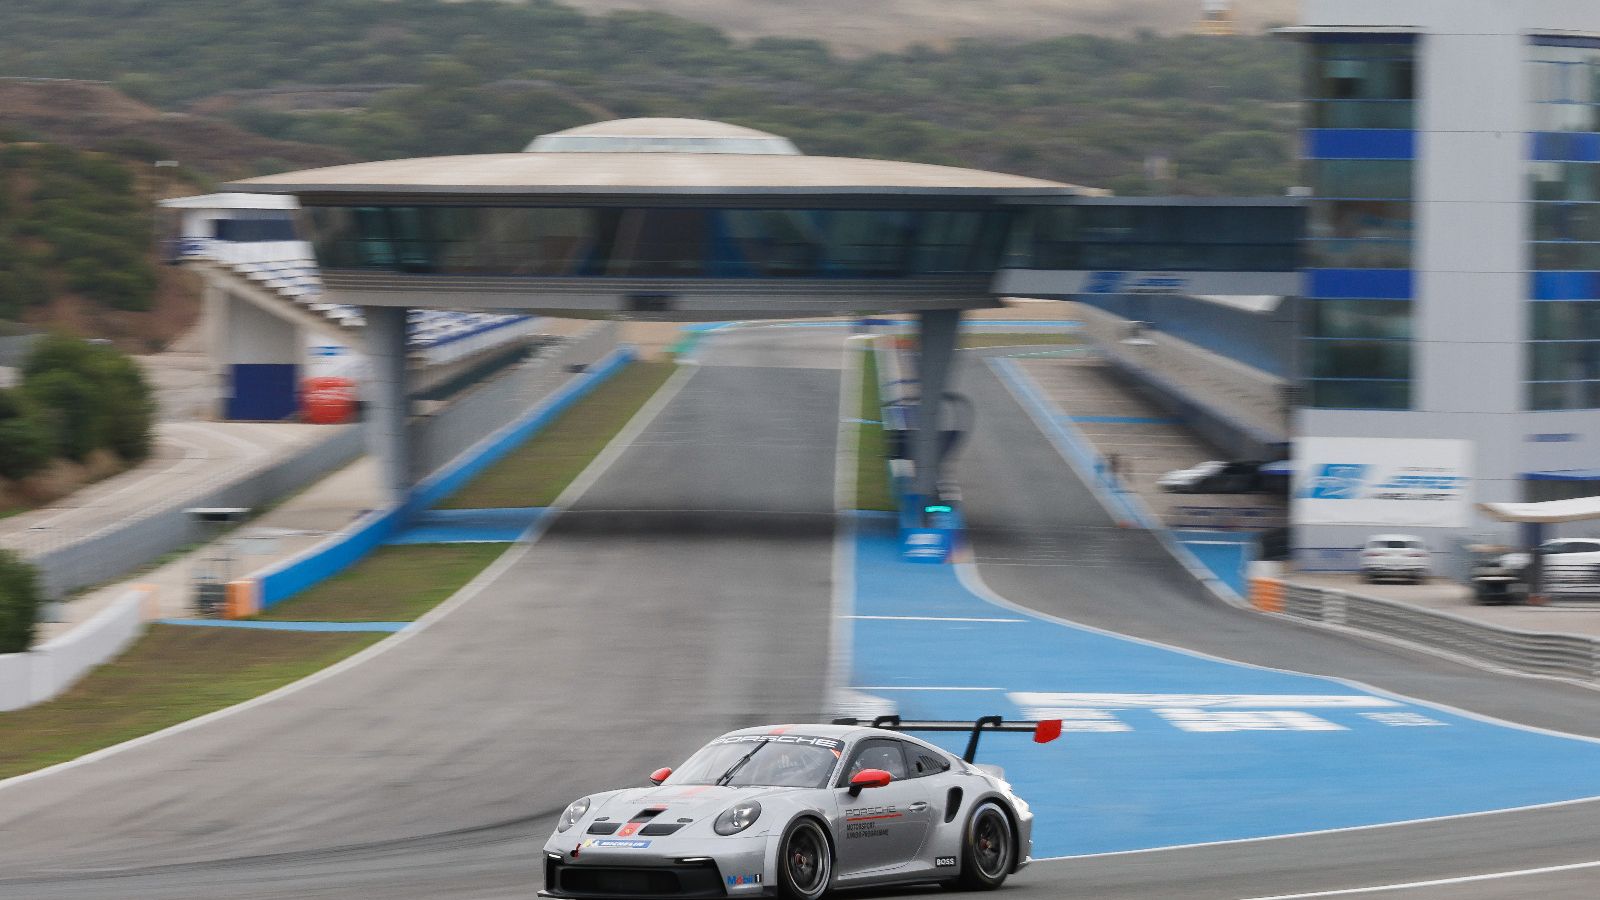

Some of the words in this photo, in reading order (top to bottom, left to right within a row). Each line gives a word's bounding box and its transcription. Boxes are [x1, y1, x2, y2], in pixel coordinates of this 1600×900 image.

[711, 735, 838, 747] PORSCHE
[845, 805, 896, 816] PORSCHE
[936, 858, 954, 866] BOSS
